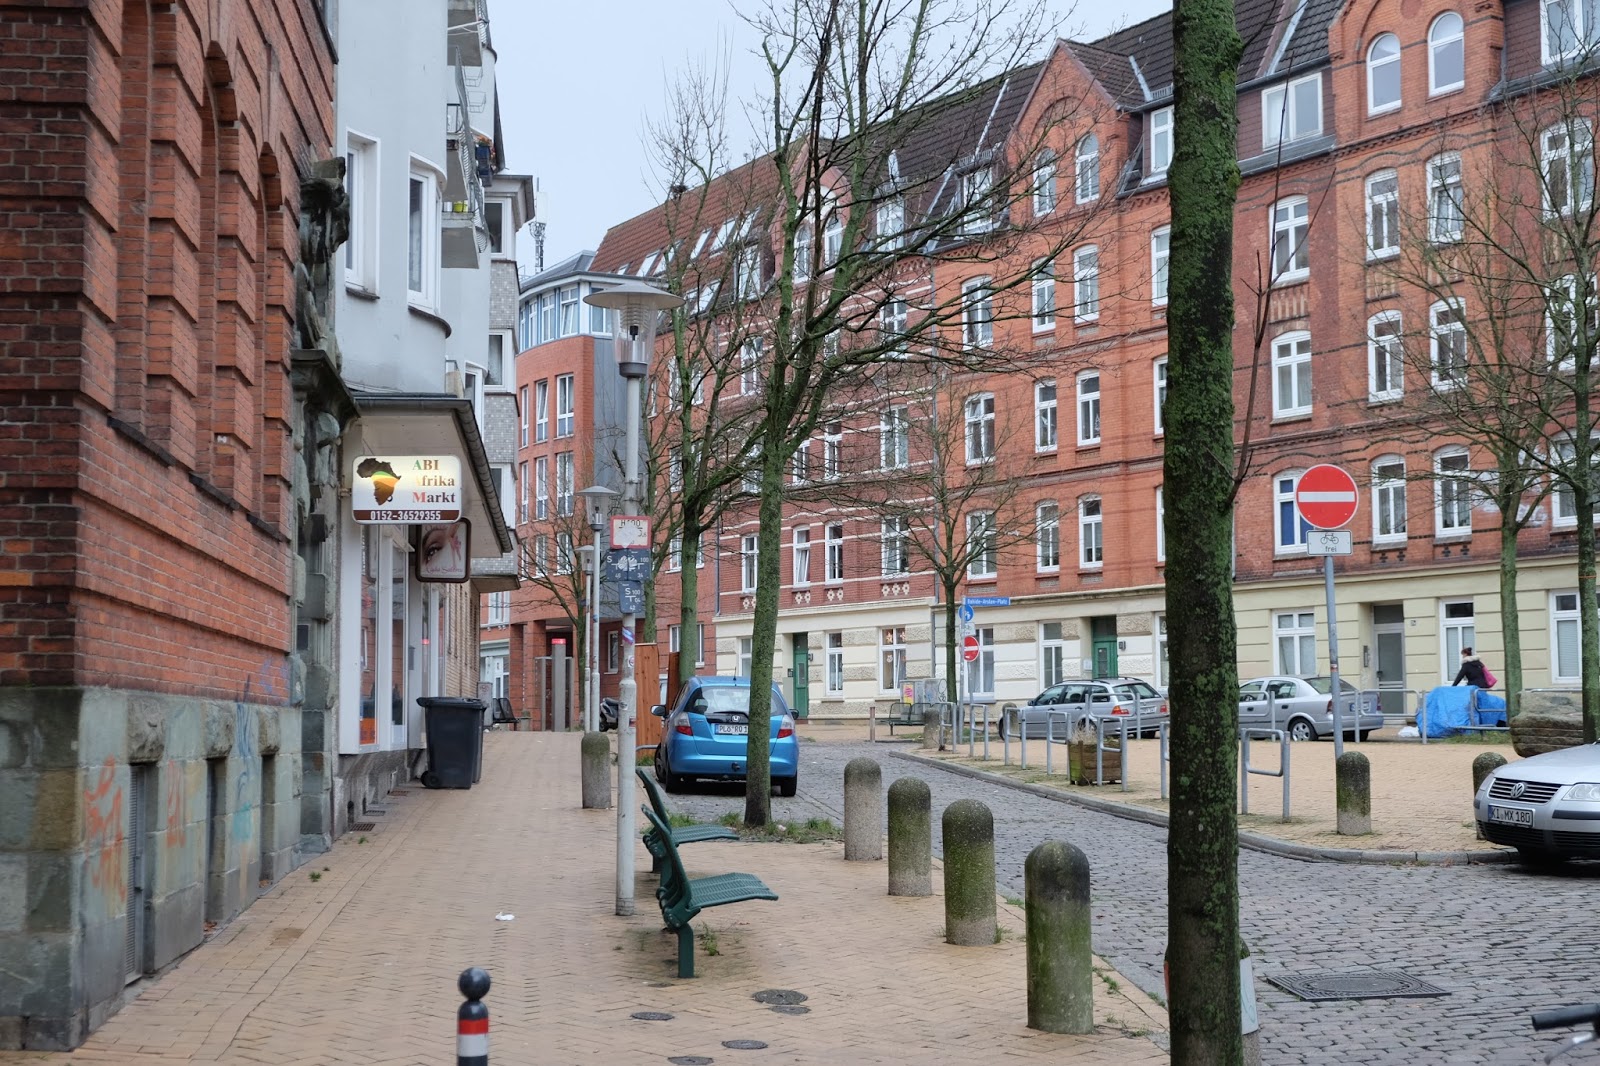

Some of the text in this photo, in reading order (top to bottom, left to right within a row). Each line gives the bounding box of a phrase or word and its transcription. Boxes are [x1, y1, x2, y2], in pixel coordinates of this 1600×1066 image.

[412, 459, 439, 471] ABI
[412, 491, 456, 503] Markt
[370, 510, 441, 521] 0152-36529355
[1491, 808, 1530, 823] KI MX 180
